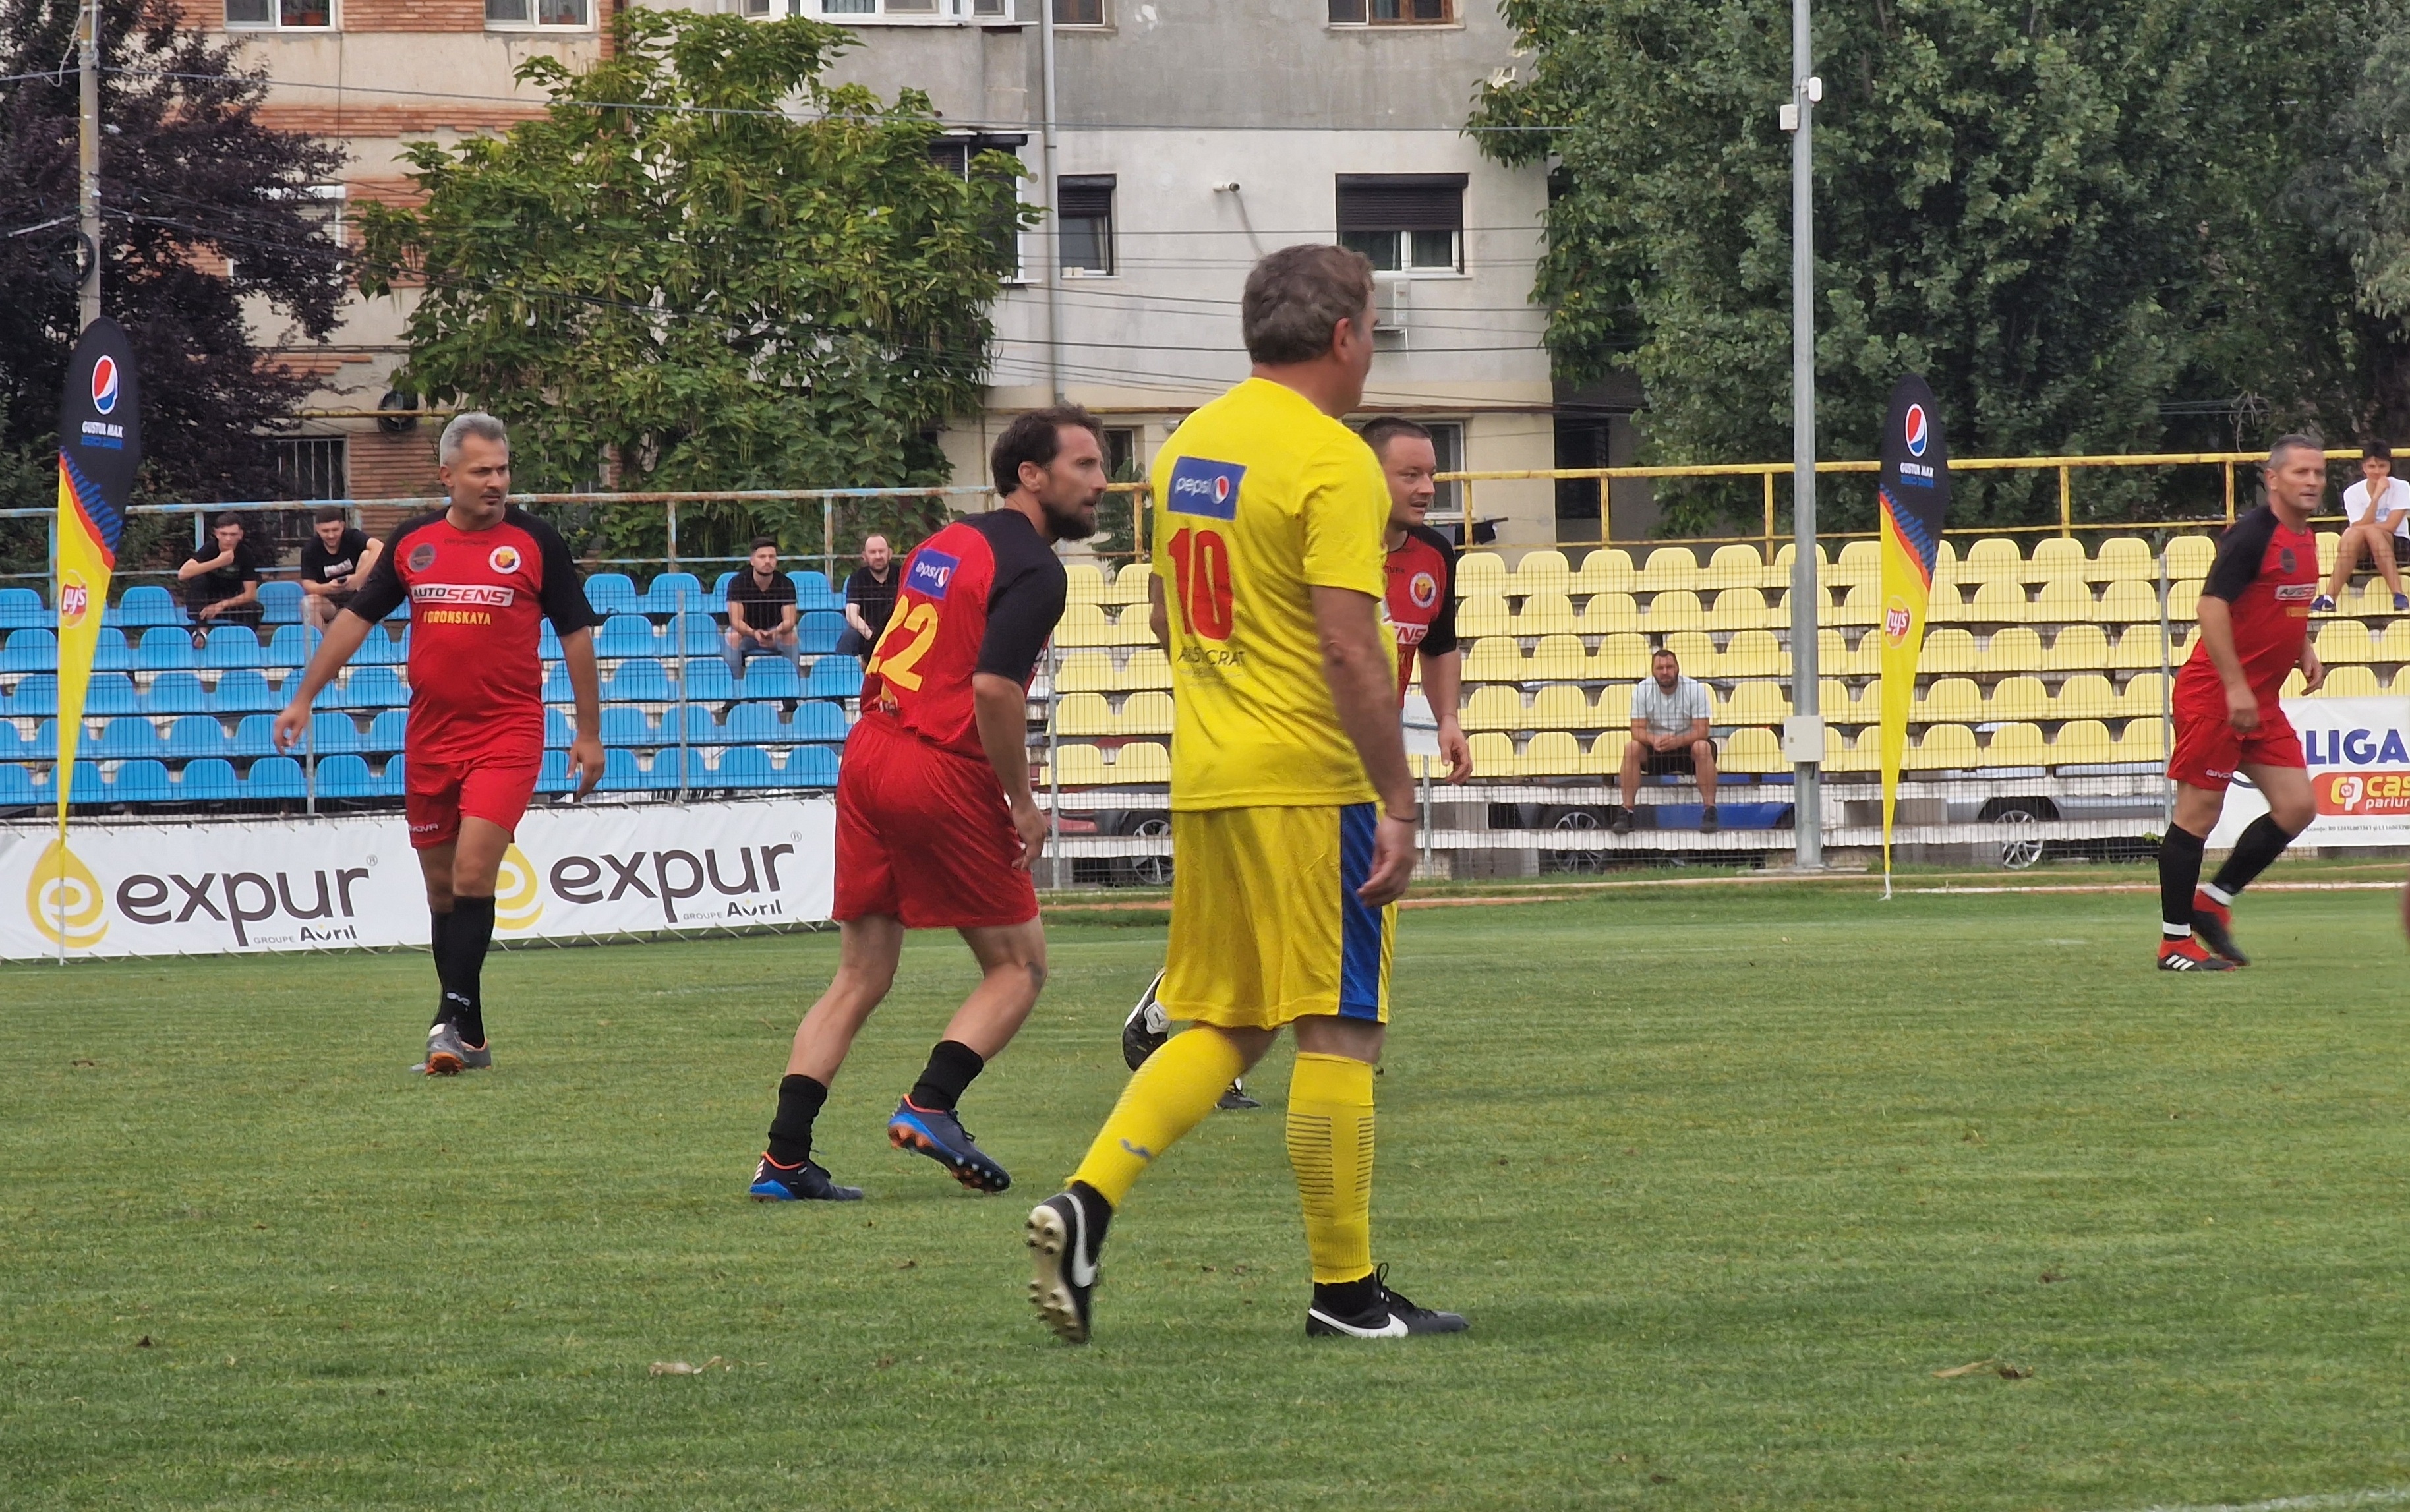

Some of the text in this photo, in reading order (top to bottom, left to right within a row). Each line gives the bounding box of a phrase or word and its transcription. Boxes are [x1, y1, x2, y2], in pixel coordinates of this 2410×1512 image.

[1175, 477, 1213, 496] pepsi
[1167, 527, 1235, 641] 10
[2306, 728, 2410, 765] LIGA
[683, 899, 782, 921] GROUPE Avril
[254, 924, 358, 945] GROUPE Avril
